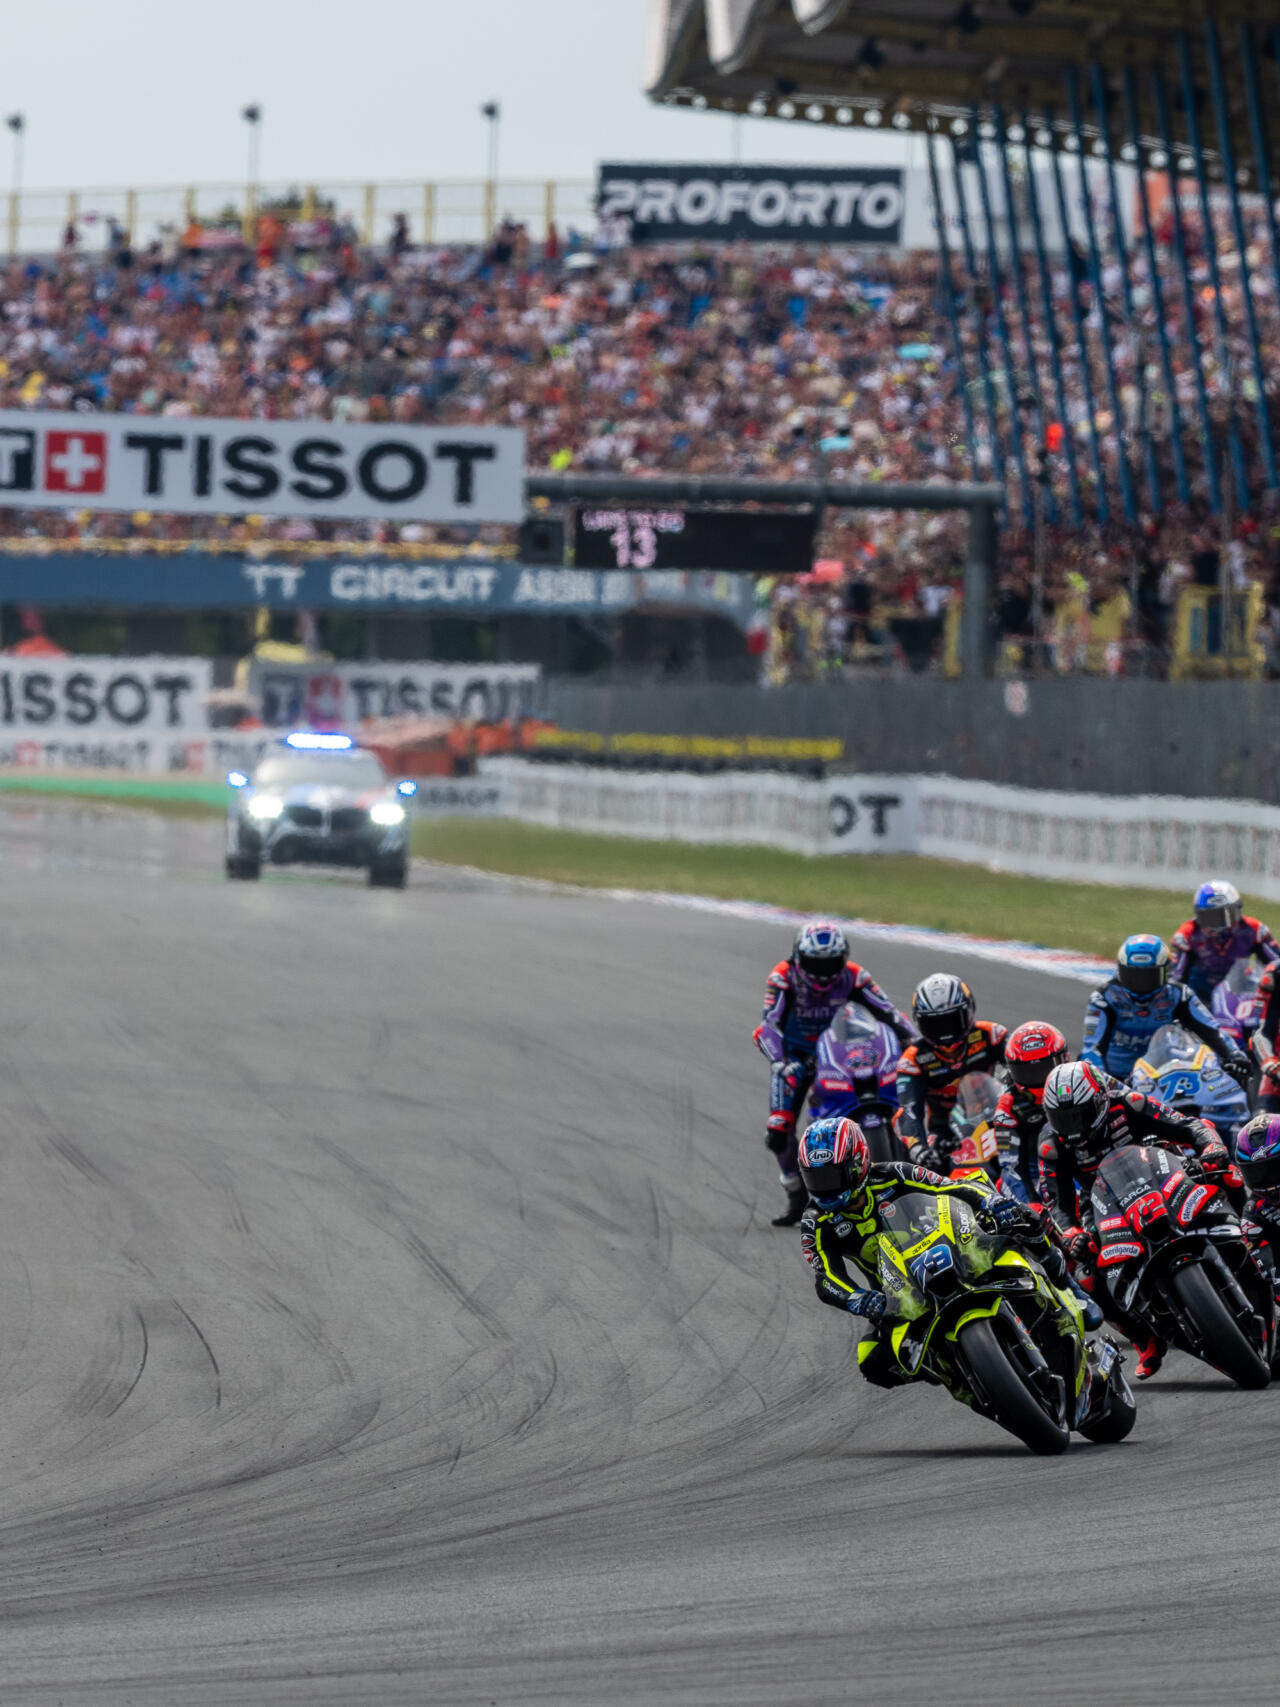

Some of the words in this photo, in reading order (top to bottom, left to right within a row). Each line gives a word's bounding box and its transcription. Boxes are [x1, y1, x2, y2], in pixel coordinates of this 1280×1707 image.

[602, 179, 902, 228] PROFORTO
[126, 432, 495, 504] TISSOT
[610, 528, 657, 568] 13
[245, 563, 303, 598] TT
[330, 563, 497, 600] CIRCUIT
[809, 1150, 832, 1160] Arai
[1120, 1184, 1151, 1207] TARGA
[1183, 1186, 1205, 1219] sterilgarda
[1103, 1246, 1139, 1258] sterilgarda
[1107, 1266, 1122, 1279] sky
